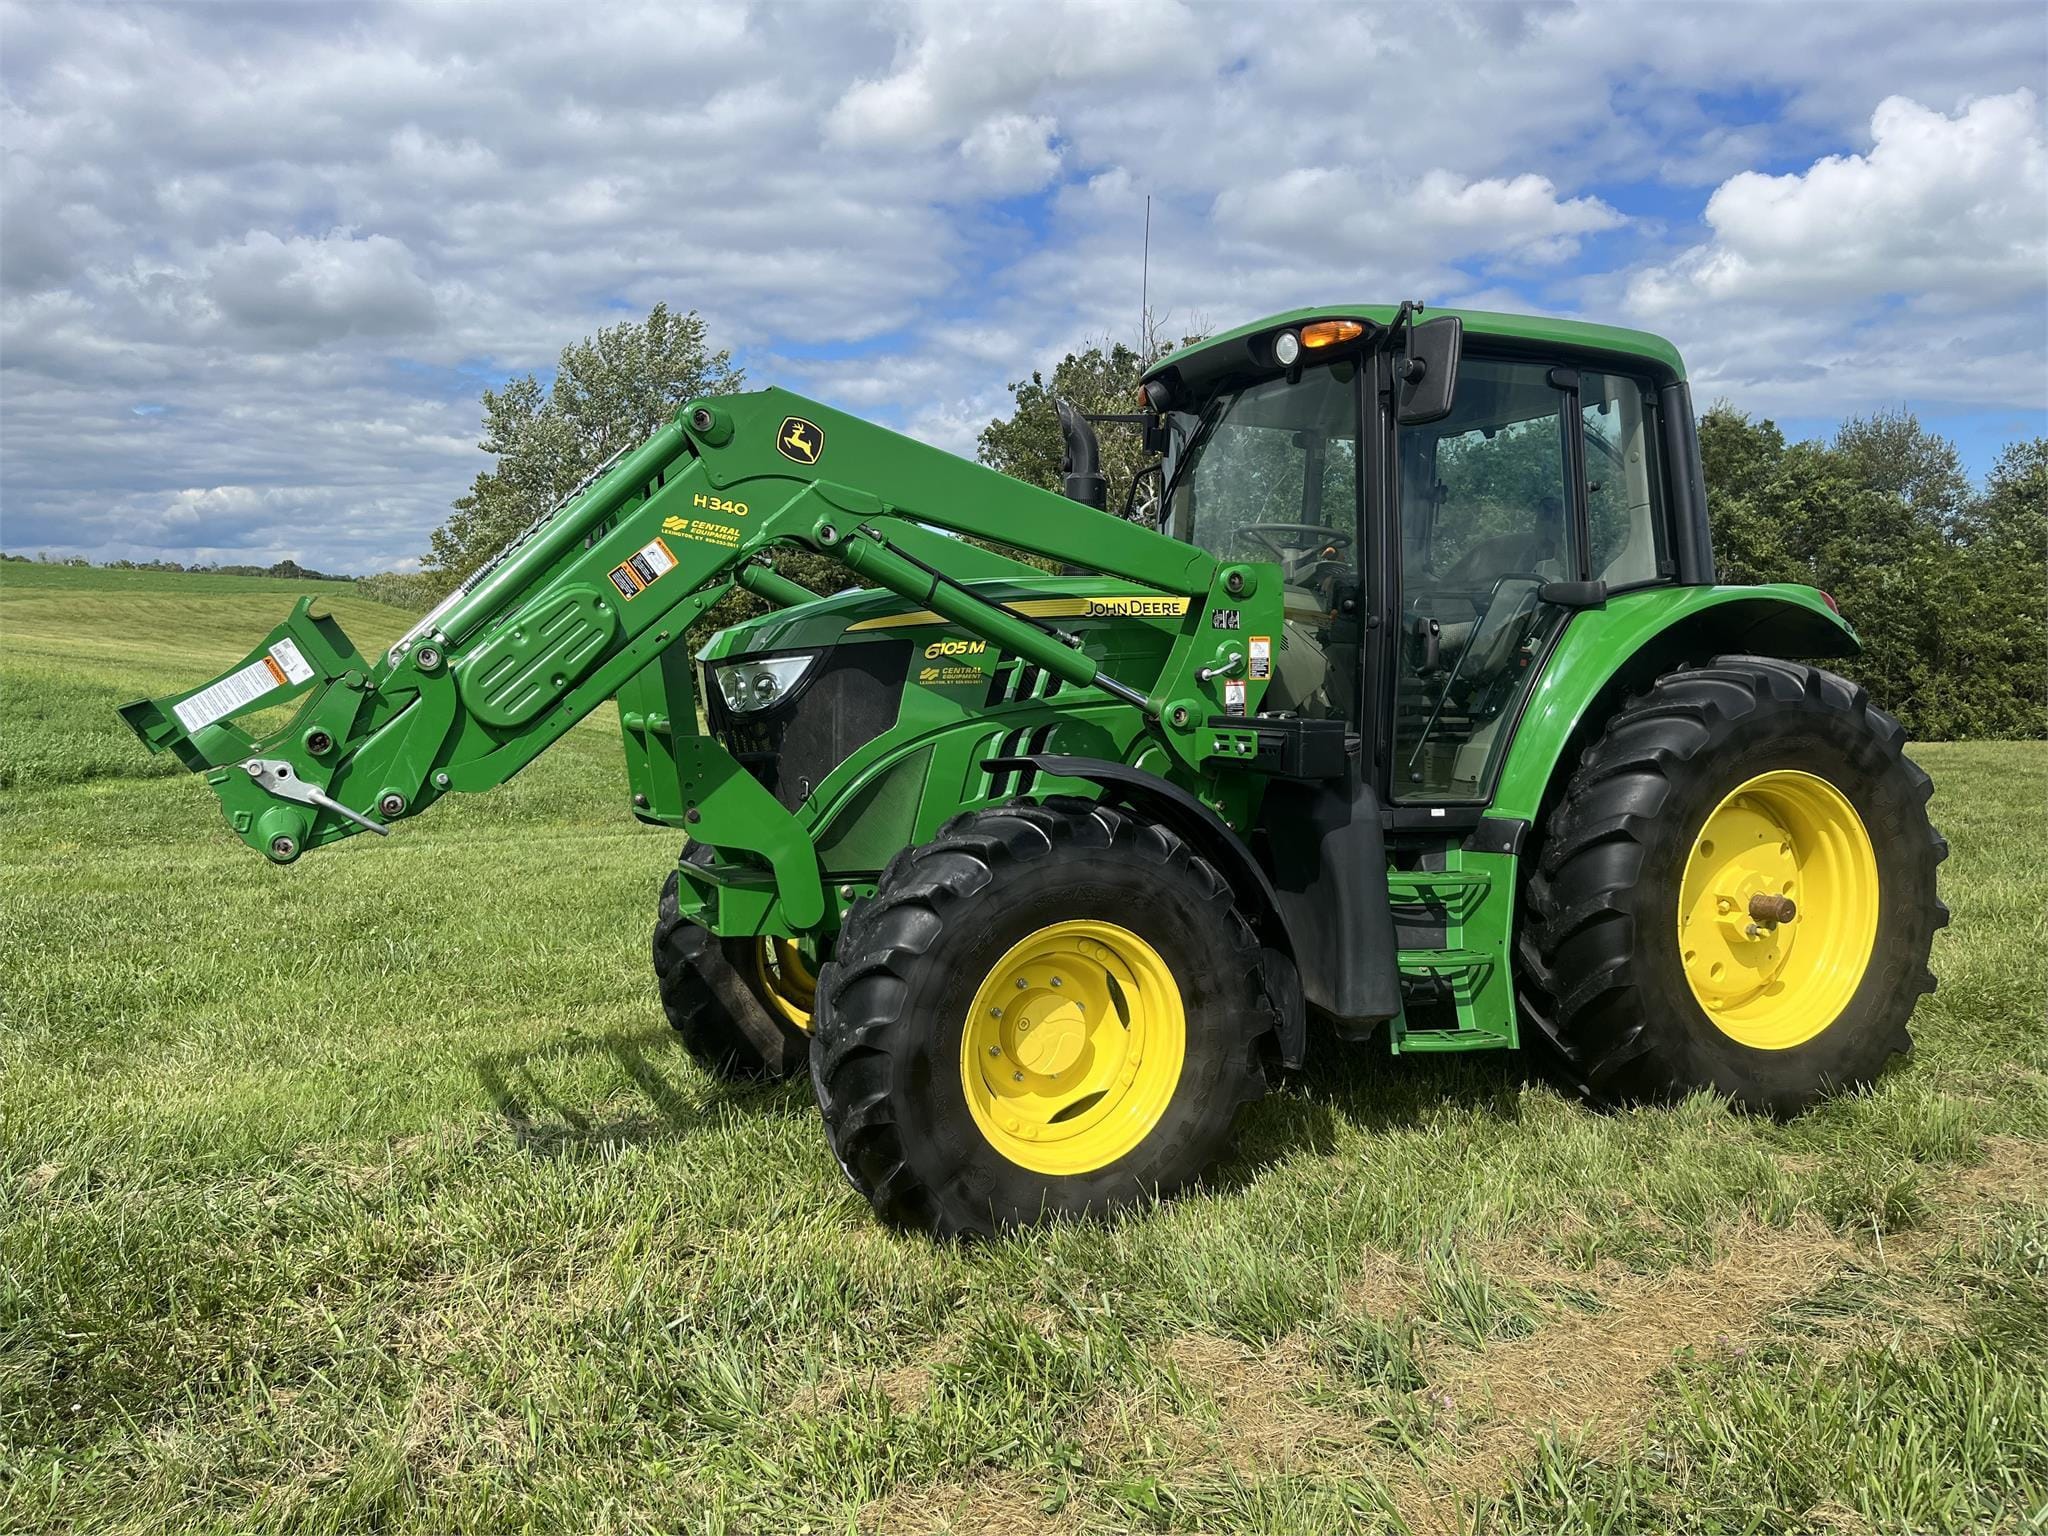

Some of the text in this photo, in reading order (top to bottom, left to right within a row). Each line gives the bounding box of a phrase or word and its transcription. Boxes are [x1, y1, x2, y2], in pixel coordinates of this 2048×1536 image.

[690, 527, 739, 542] EQUIPMENT
[691, 520, 741, 537] CENTRAL
[1086, 600, 1181, 615] JOHN DEERE
[942, 666, 982, 674] CENTRAL
